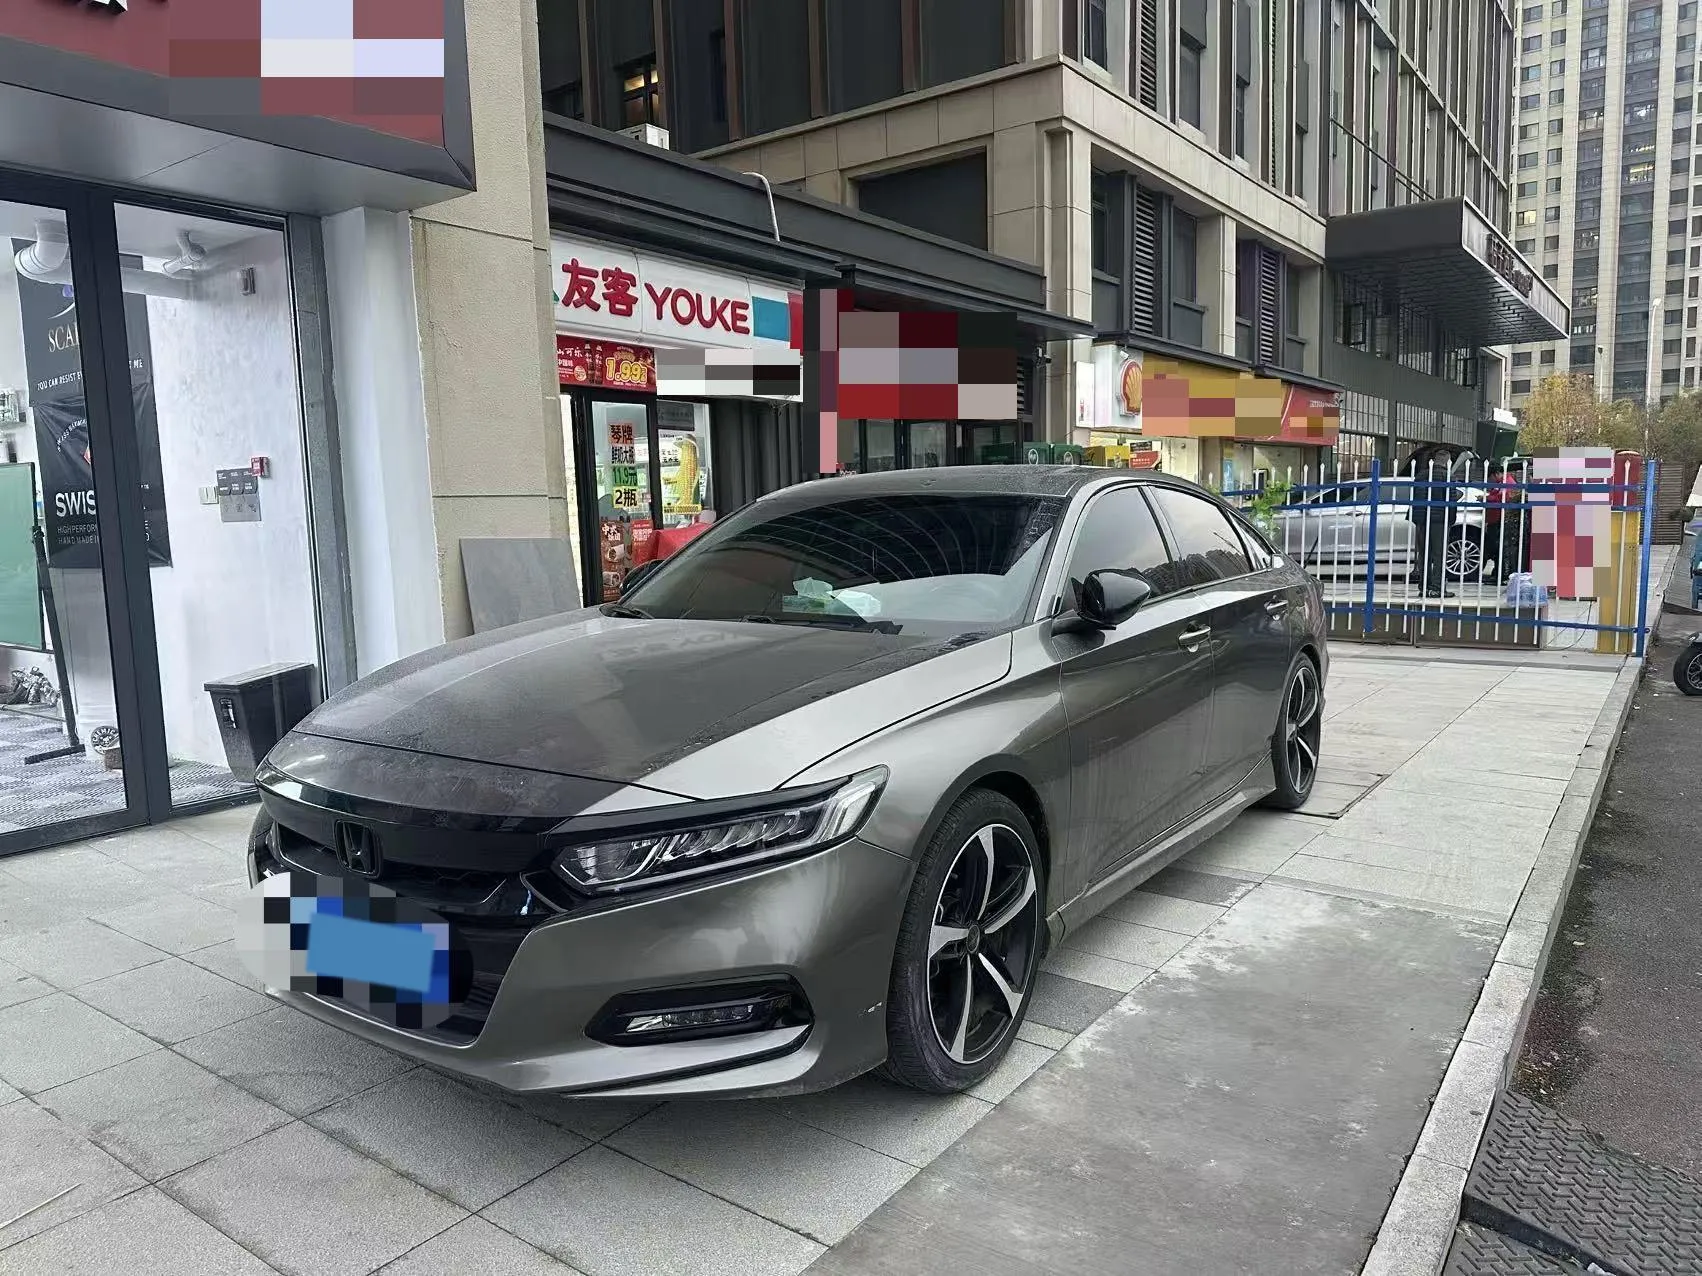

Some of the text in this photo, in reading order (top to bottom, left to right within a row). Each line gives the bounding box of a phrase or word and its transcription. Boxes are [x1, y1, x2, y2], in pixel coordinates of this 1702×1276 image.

[561, 257, 639, 318] 友客
[643, 282, 751, 335] YOUKE
[615, 489, 638, 507] 2瓶
